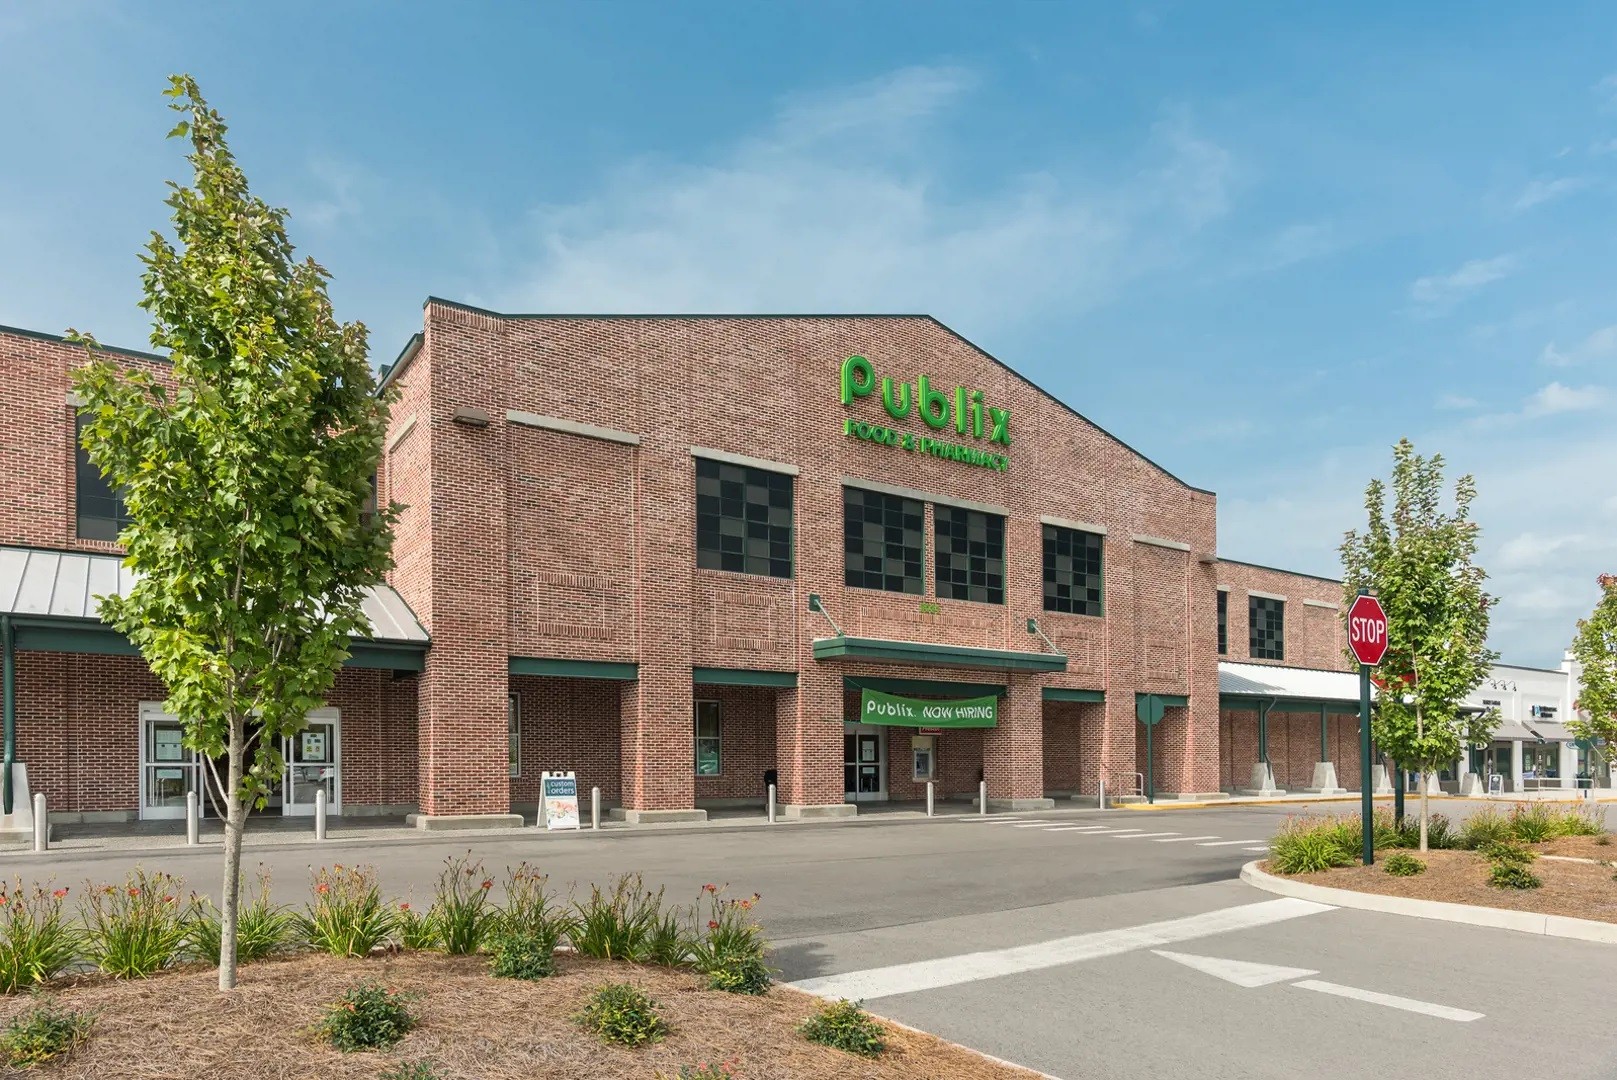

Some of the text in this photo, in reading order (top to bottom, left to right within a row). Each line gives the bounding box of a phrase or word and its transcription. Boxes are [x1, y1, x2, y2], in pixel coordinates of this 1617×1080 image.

[841, 355, 1011, 446] Publix
[843, 419, 1008, 471] FOOD & PHARMACY
[1351, 617, 1385, 643] STOP
[922, 706, 952, 718] NOW
[955, 706, 993, 719] HIRING
